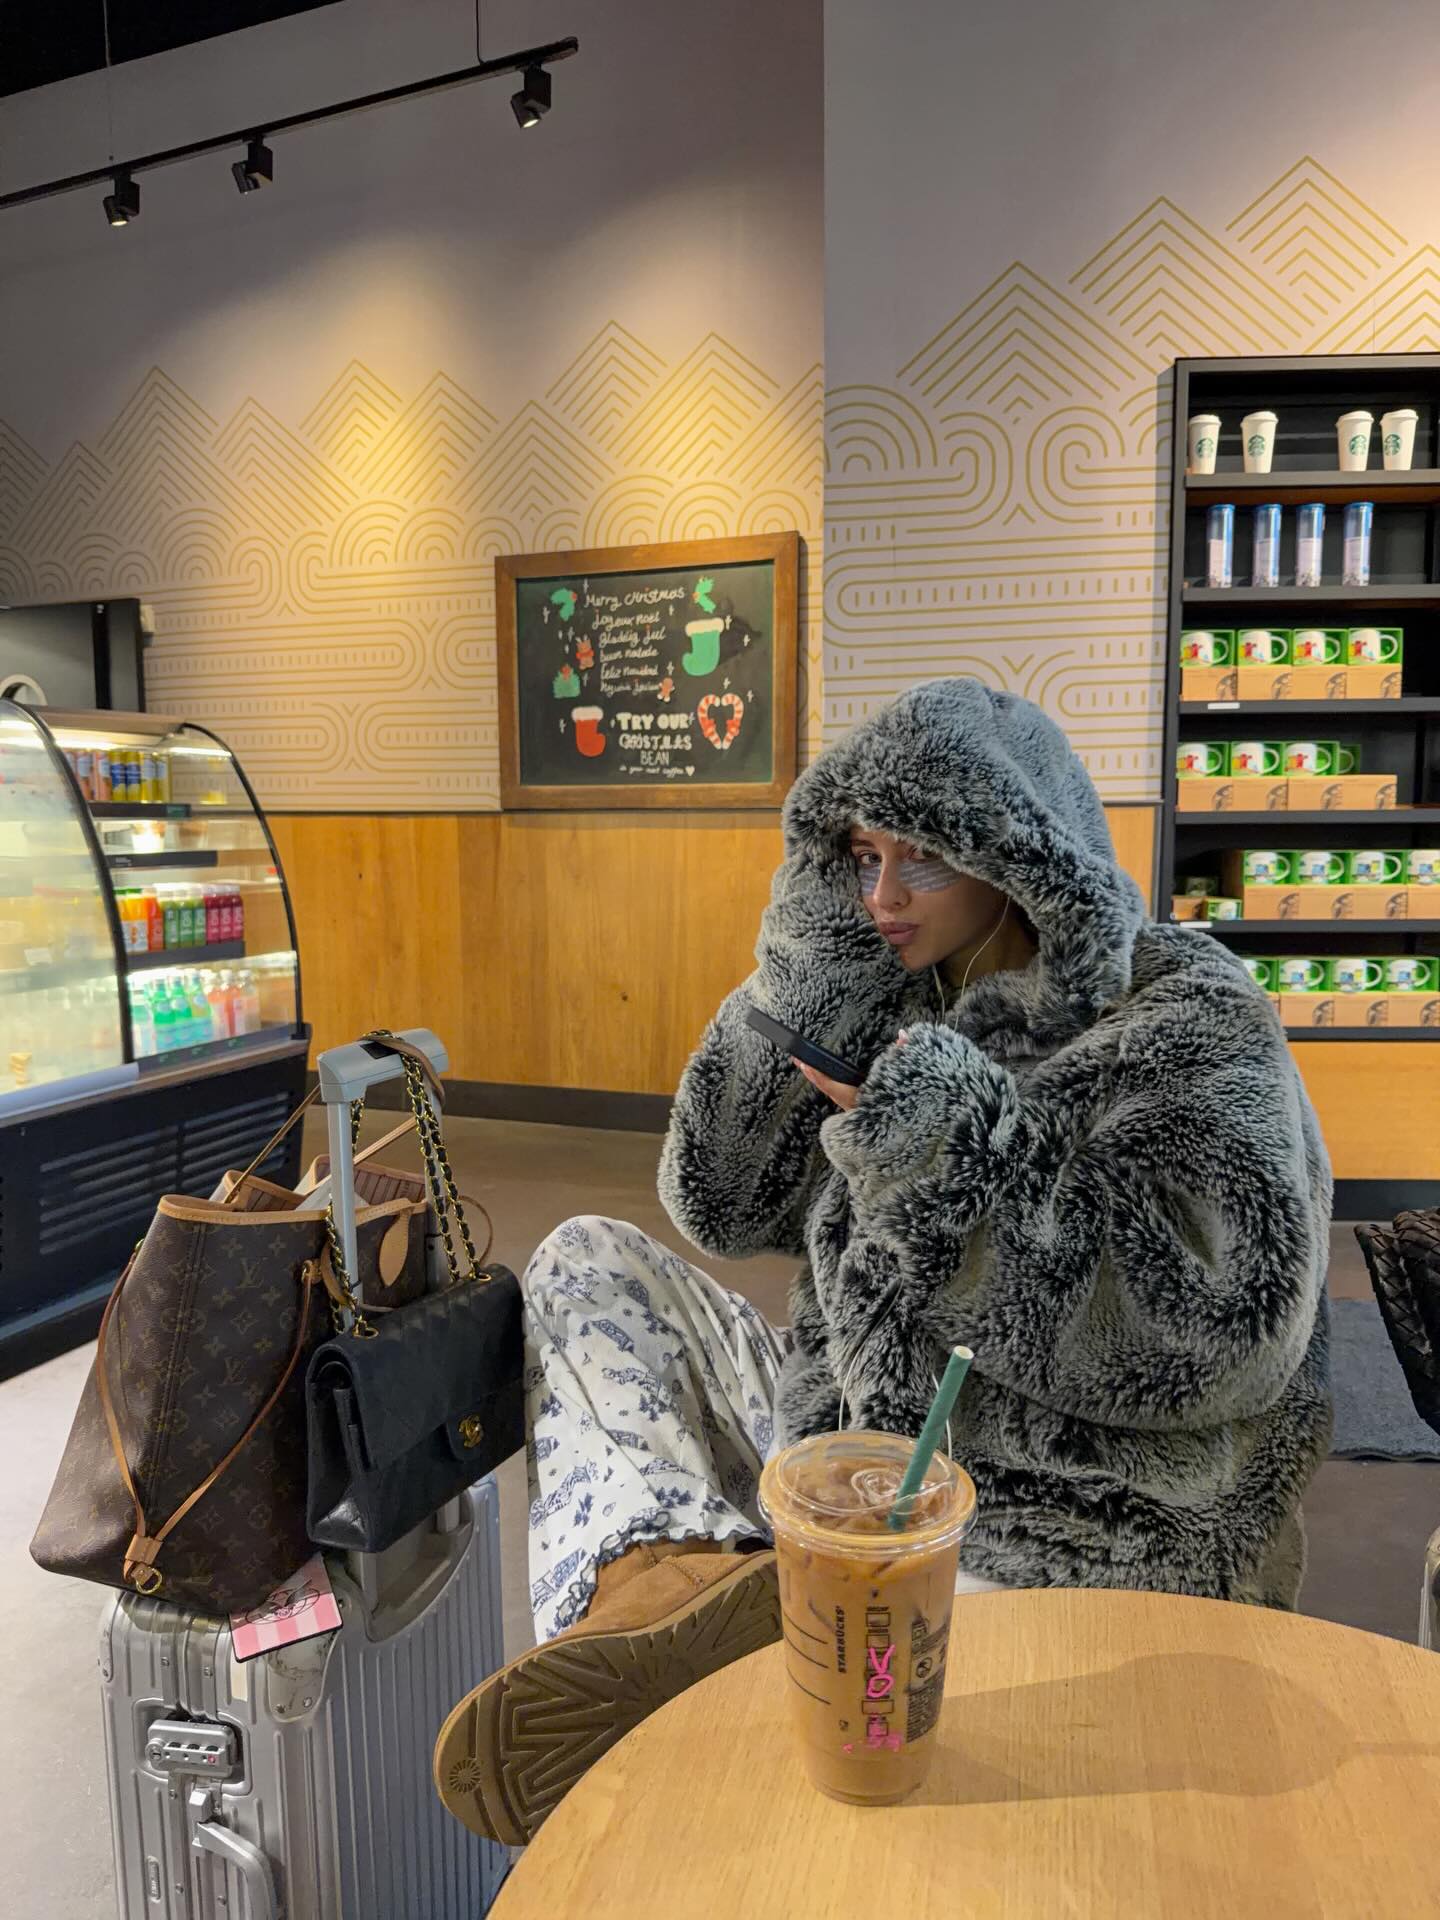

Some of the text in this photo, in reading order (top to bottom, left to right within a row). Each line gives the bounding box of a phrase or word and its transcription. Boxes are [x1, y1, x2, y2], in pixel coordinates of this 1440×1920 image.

[616, 712, 689, 730] TRY OUR
[641, 750, 669, 766] BEAN
